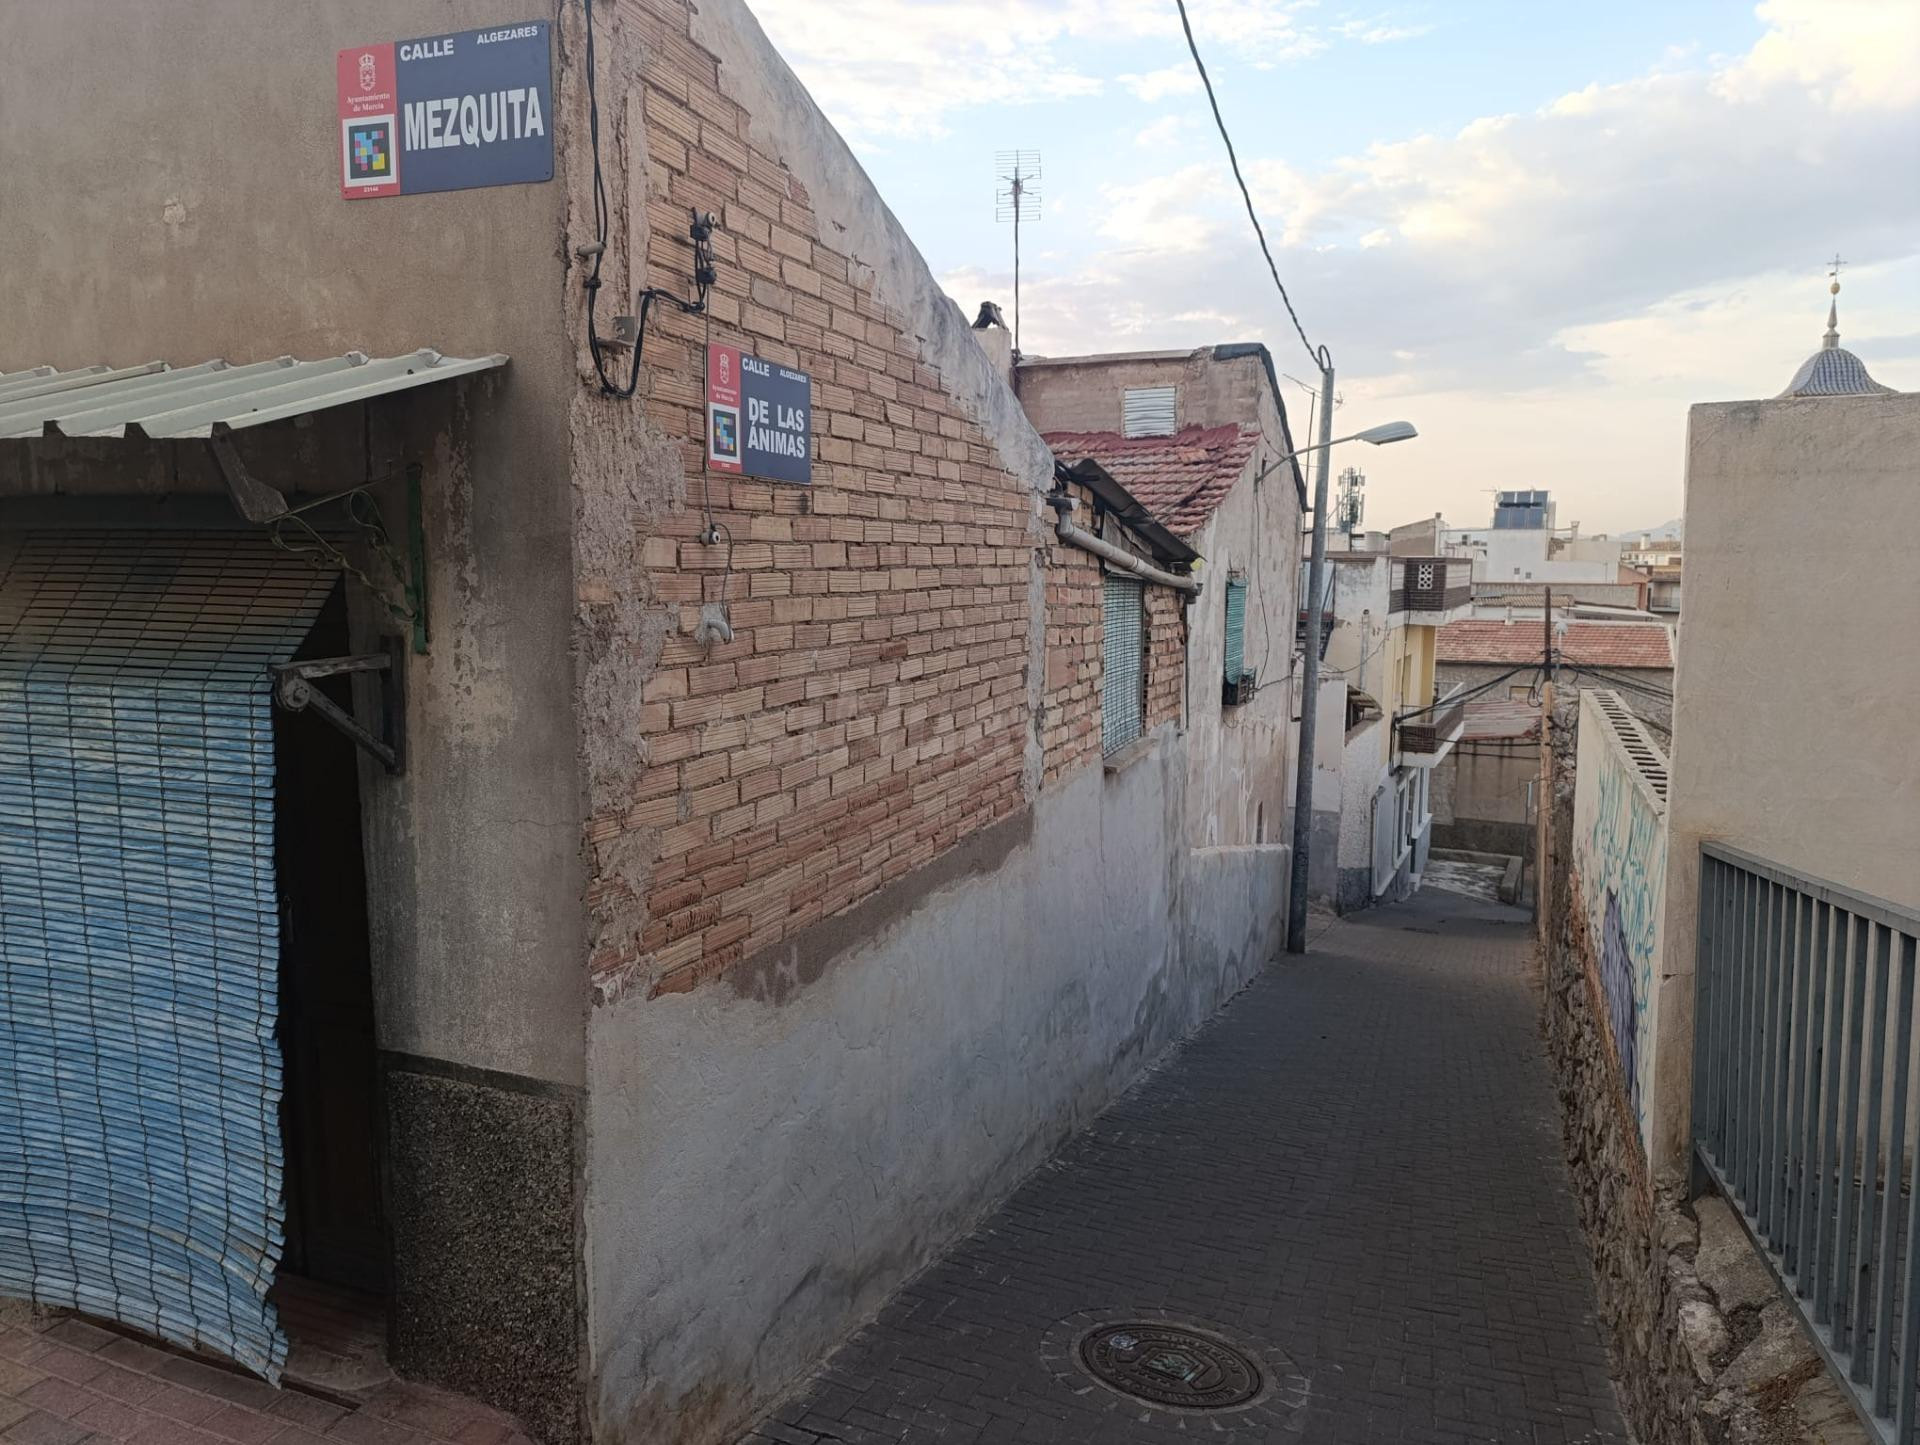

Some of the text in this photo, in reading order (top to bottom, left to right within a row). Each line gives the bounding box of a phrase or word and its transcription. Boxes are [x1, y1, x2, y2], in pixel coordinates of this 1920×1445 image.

[477, 26, 538, 44] ALGEZARES
[400, 39, 454, 61] CALLE
[347, 92, 390, 105] Ayuntamiento
[353, 103, 384, 112] de Murcia
[404, 87, 544, 151] MEZQUITA
[742, 358, 770, 376] CALLE
[748, 397, 805, 432] DE LAS
[748, 420, 805, 458] ÁNIMAS
